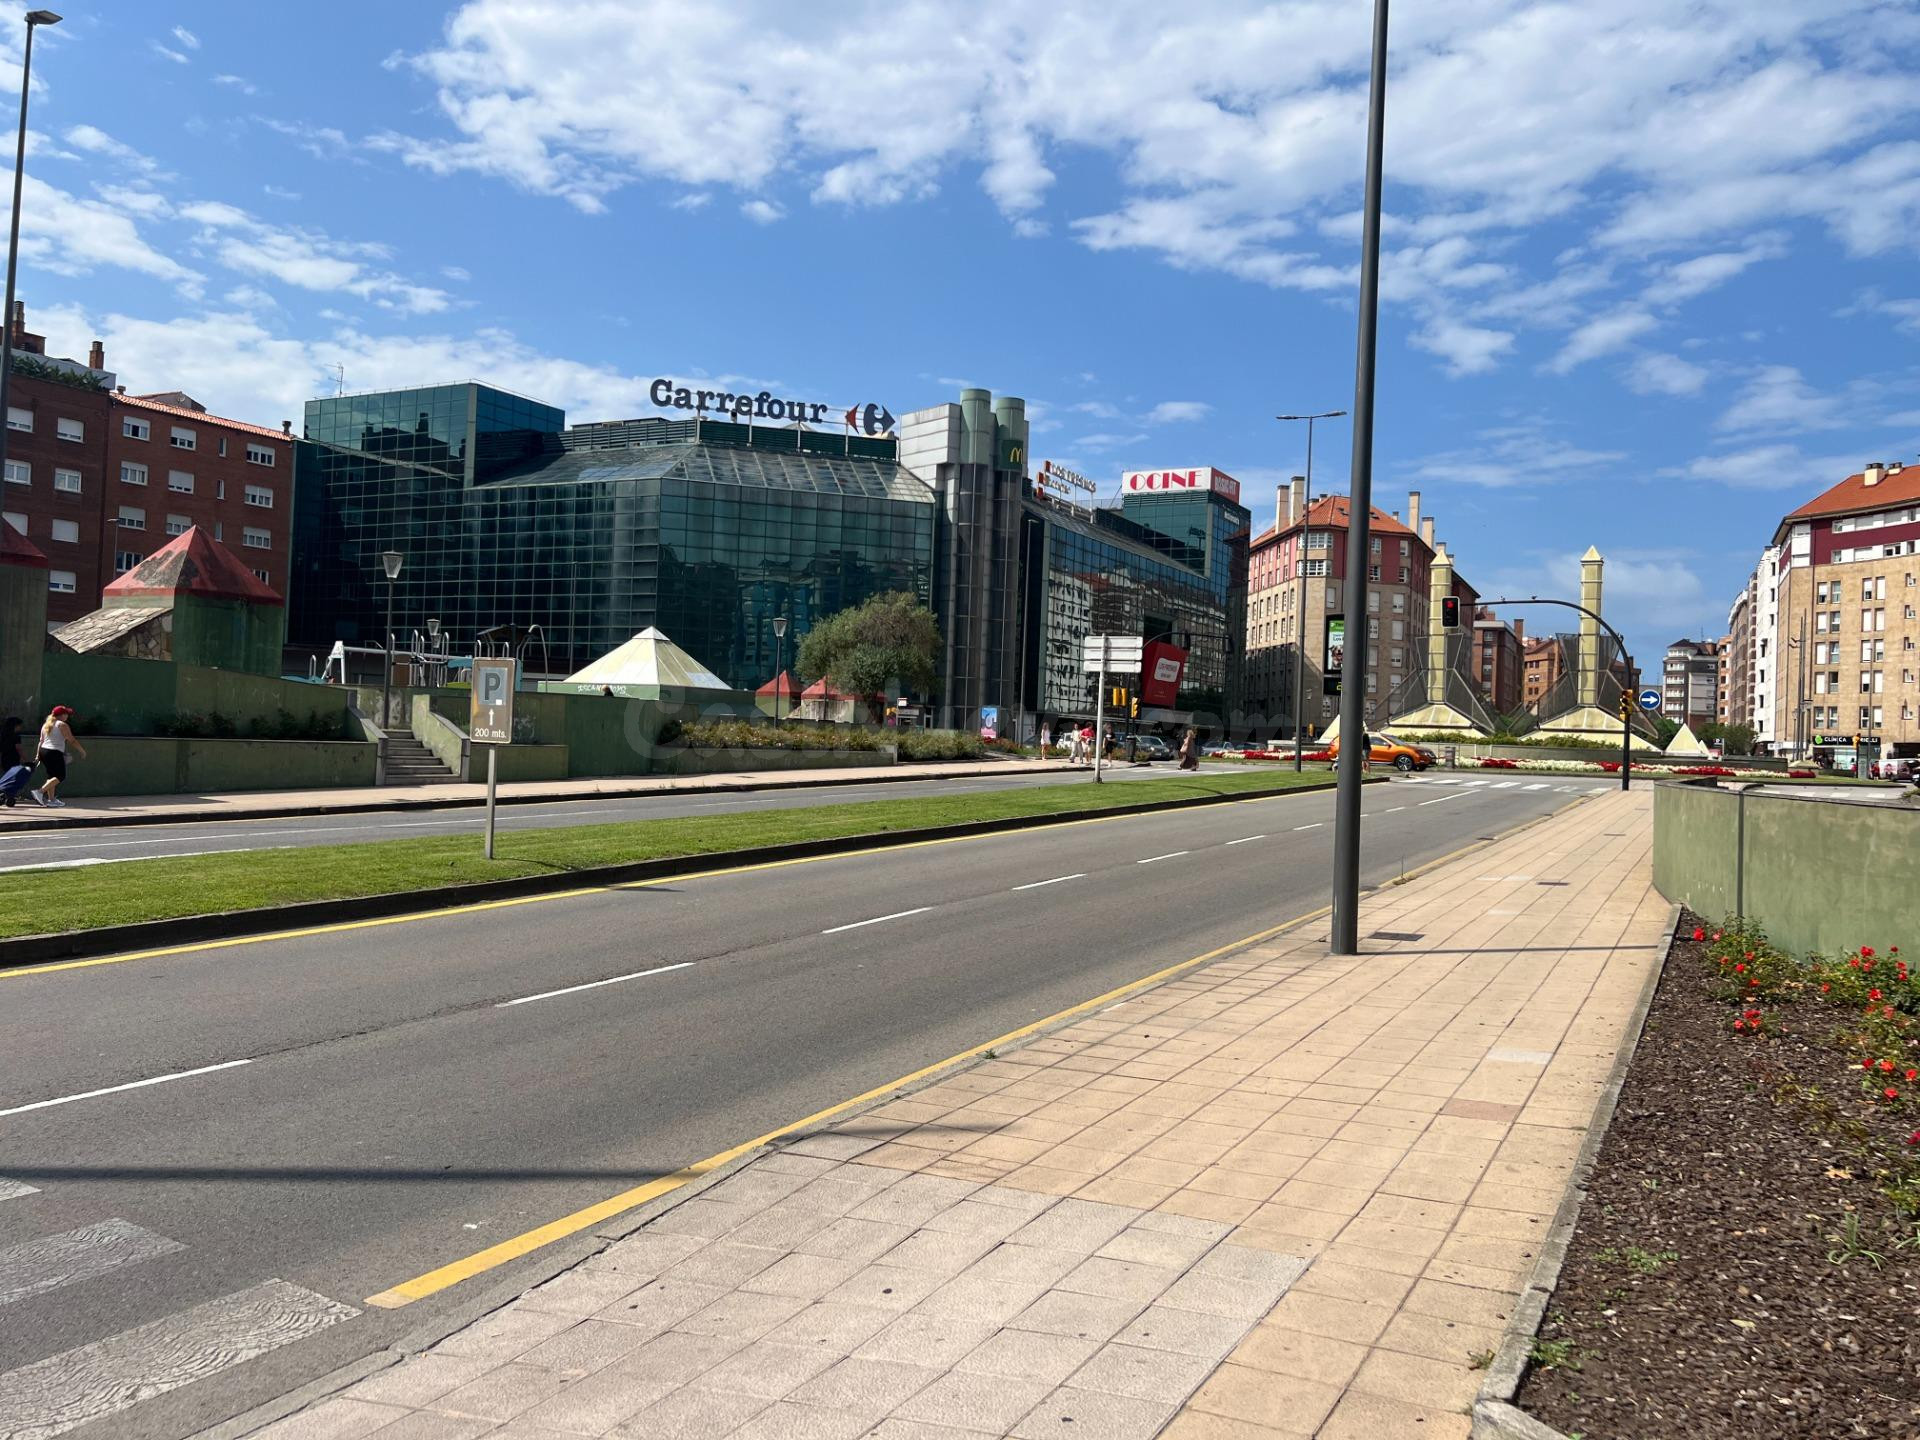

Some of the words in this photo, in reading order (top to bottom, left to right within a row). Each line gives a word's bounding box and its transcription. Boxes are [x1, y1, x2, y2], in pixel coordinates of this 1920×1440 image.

[650, 379, 828, 424] Carrefour
[1129, 470, 1202, 490] OCINE
[485, 673, 501, 700] P
[475, 727, 489, 738] 200
[491, 729, 507, 739] mts.
